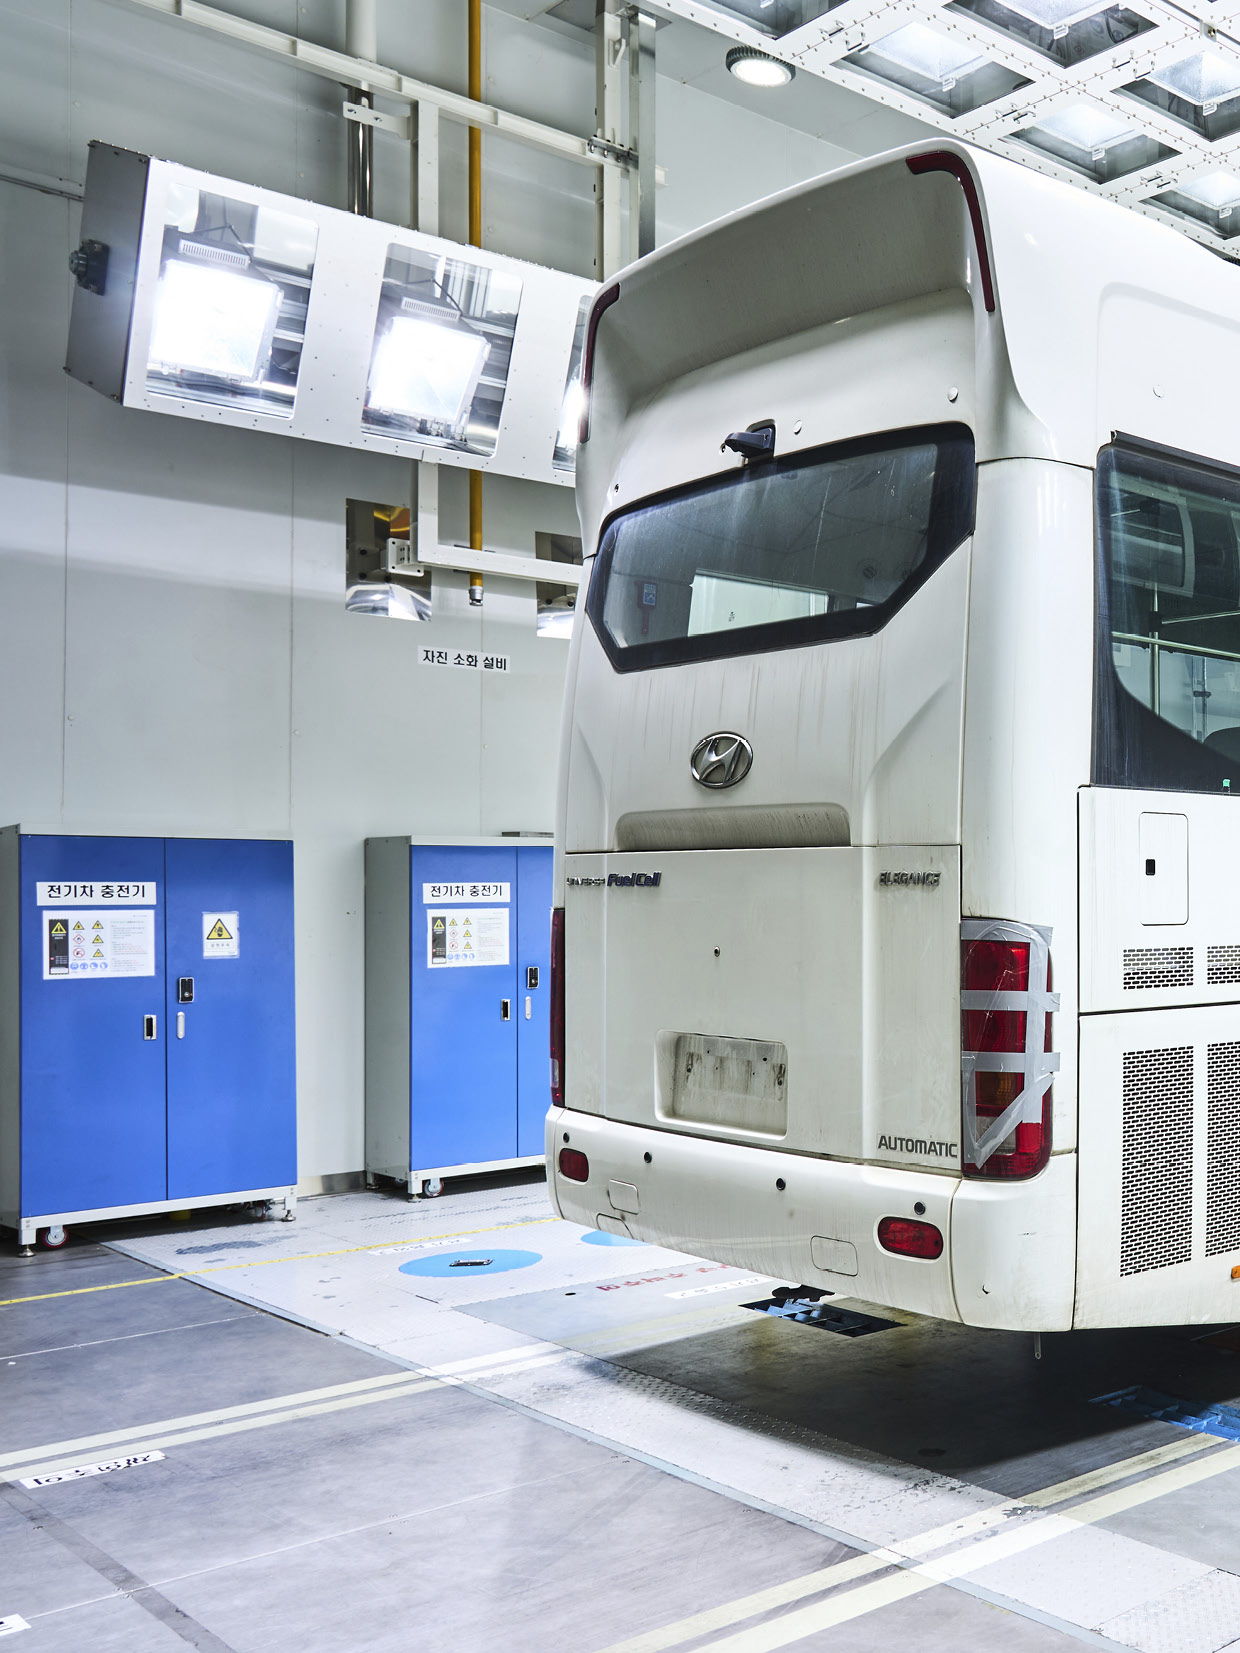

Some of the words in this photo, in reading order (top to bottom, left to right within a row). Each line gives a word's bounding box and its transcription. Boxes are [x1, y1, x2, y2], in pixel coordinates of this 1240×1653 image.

[422, 649, 448, 665] 자진
[453, 652, 479, 668] 소화
[483, 655, 507, 671] 설비
[879, 870, 941, 887] ELEGANCE
[47, 884, 94, 899] 전기차
[101, 884, 146, 899] 충전기
[430, 885, 465, 898] 전기차
[469, 884, 503, 898] 충전기
[877, 1134, 958, 1159] AUTOMATIC
